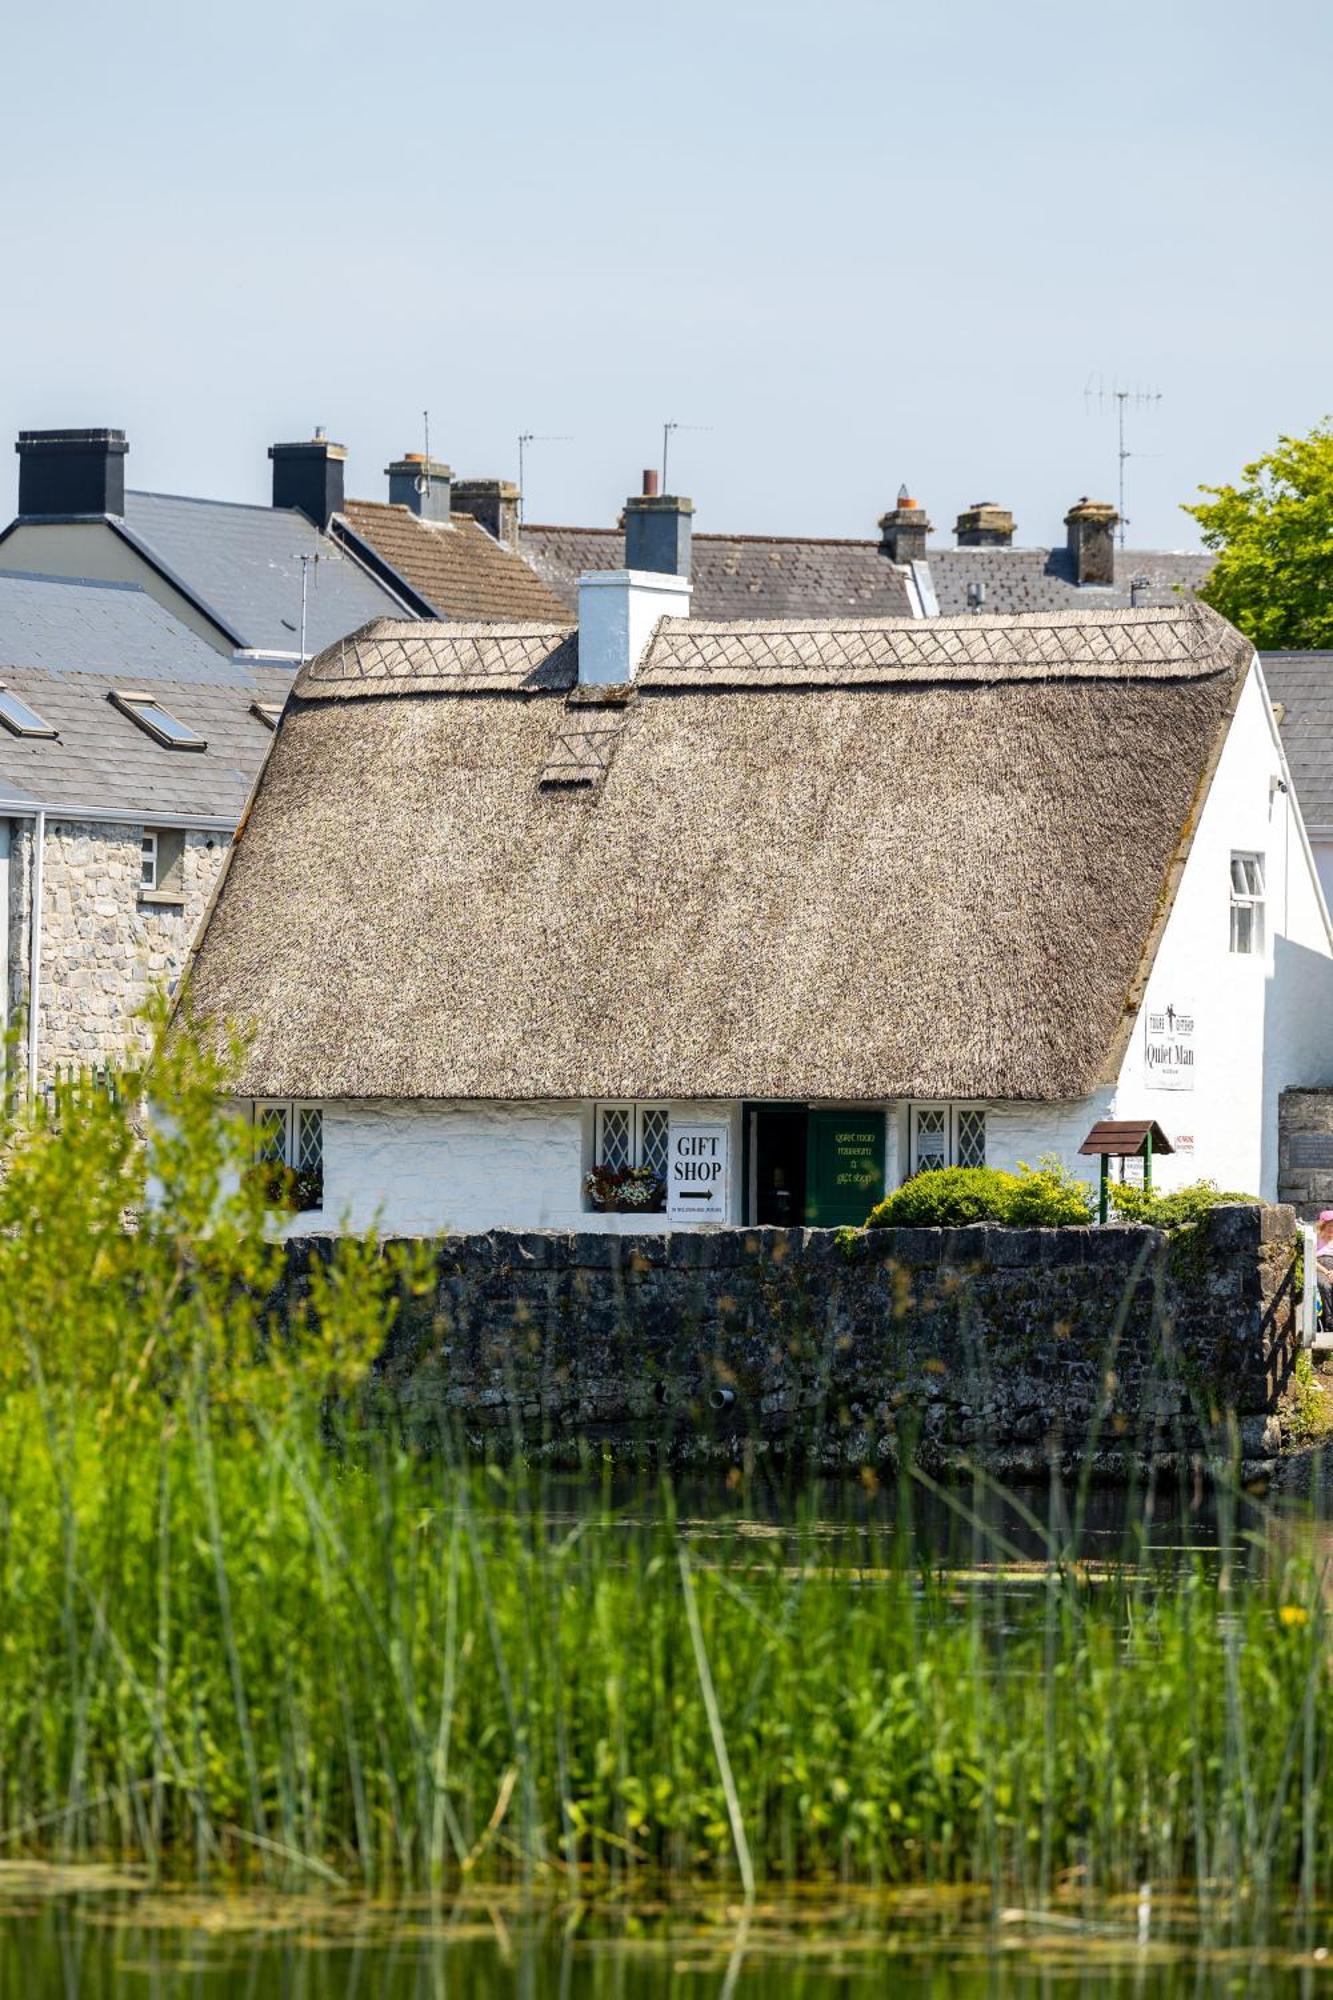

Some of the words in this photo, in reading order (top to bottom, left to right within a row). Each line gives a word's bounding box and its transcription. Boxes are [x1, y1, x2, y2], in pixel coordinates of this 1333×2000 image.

[1147, 1043, 1172, 1069] Quiet
[1174, 1045, 1194, 1065] Man
[677, 1136, 719, 1156] GIFT
[674, 1161, 722, 1181] SHOP
